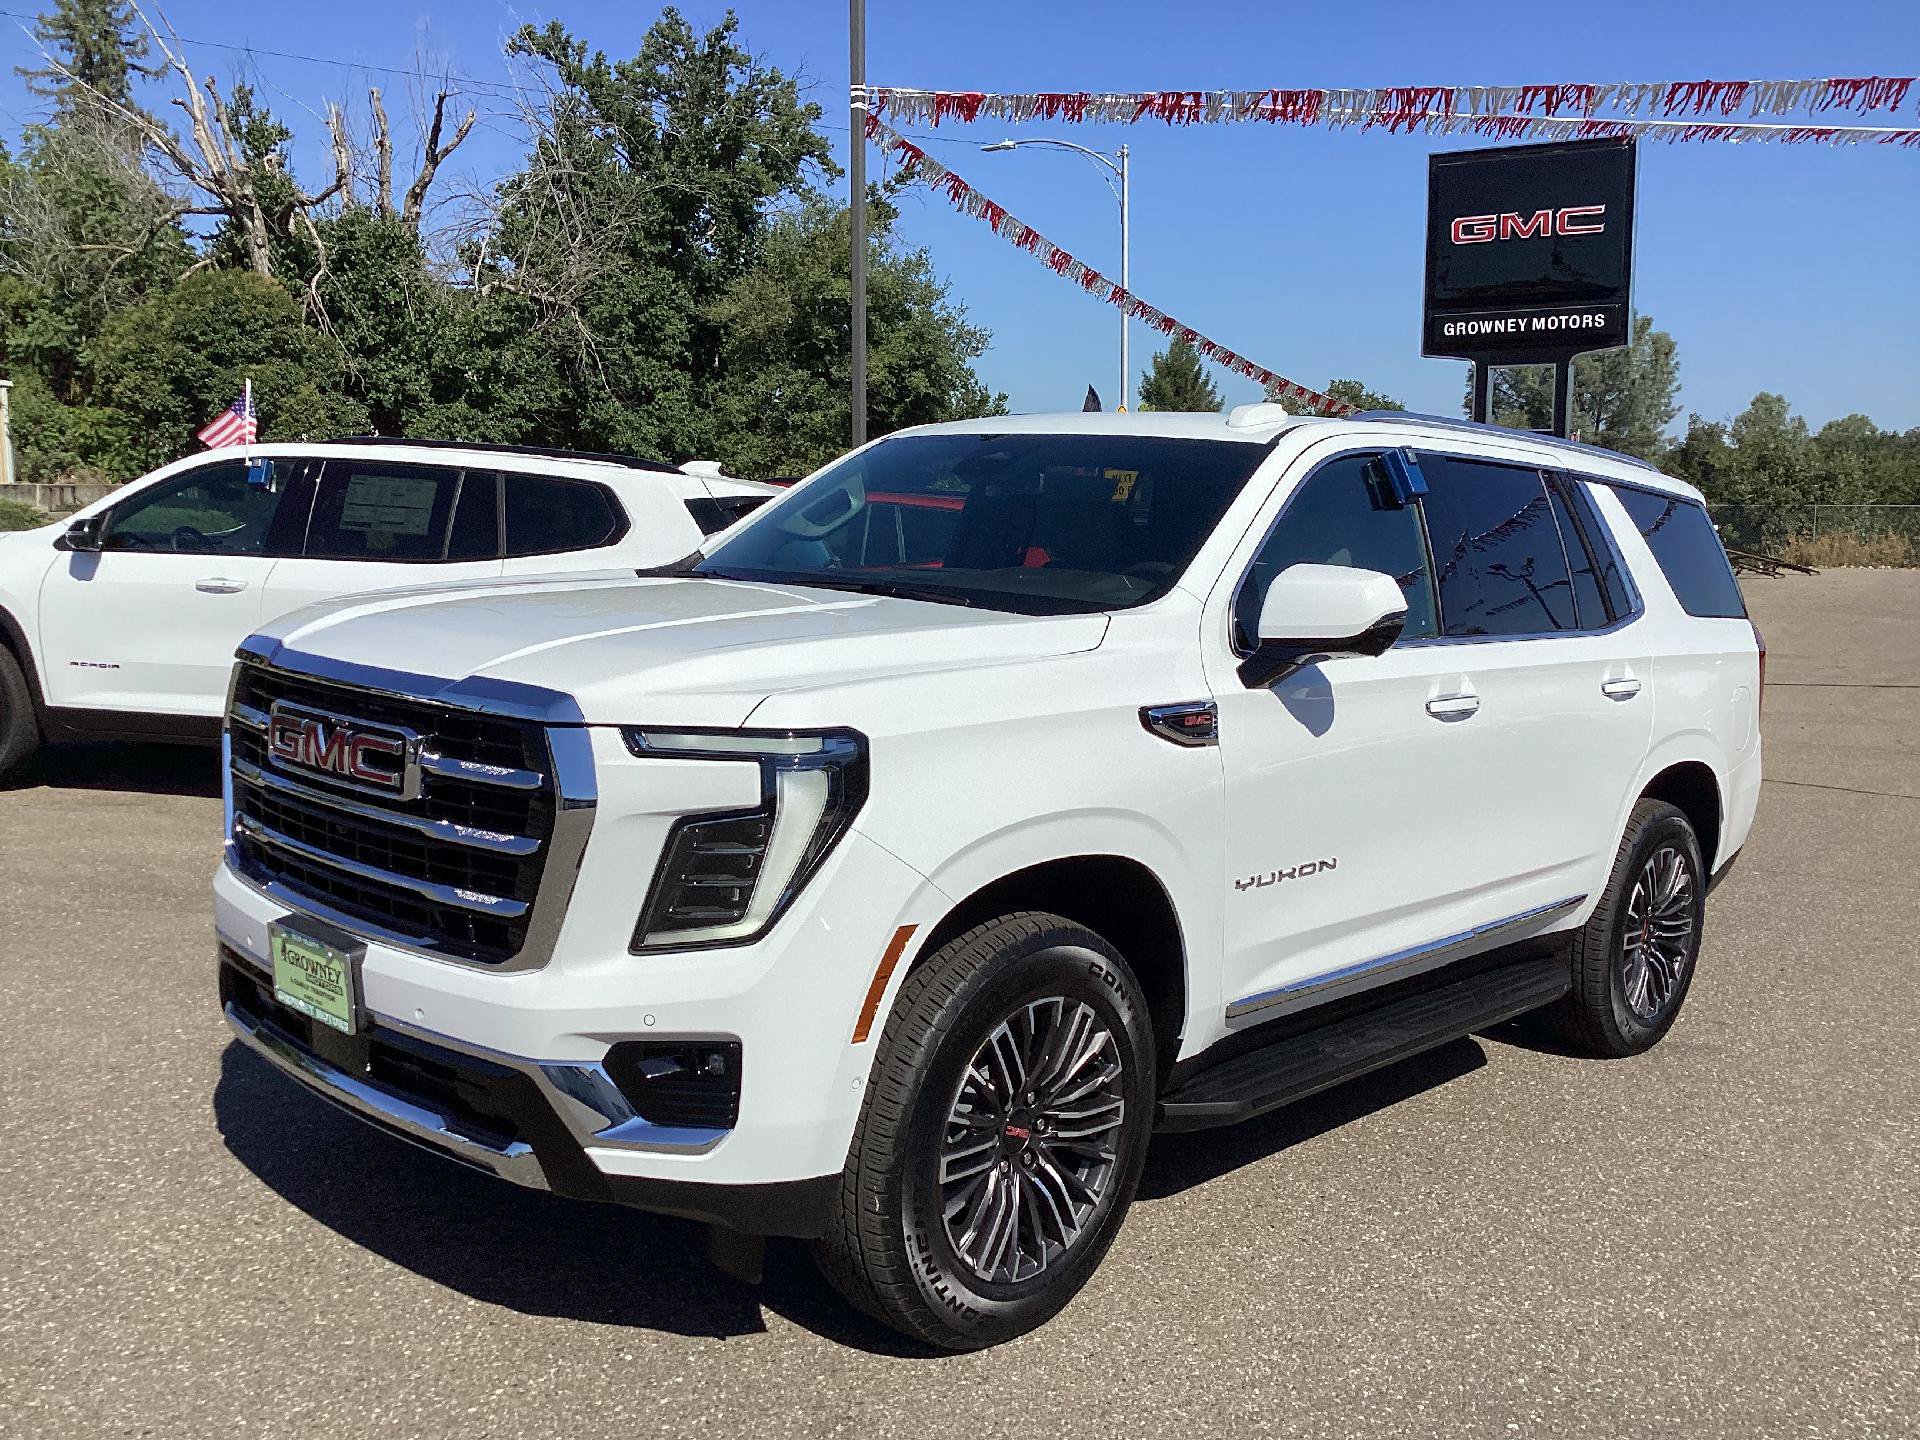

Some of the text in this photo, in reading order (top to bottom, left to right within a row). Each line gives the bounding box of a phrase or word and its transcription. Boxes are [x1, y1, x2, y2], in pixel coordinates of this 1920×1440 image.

[1451, 204, 1605, 244] GMC
[1444, 313, 1605, 336] GROWNEY MOTORS
[1184, 714, 1212, 726] GMC
[268, 713, 401, 786] GMC
[1235, 857, 1337, 891] YUKON
[287, 950, 342, 985] GROWNEY
